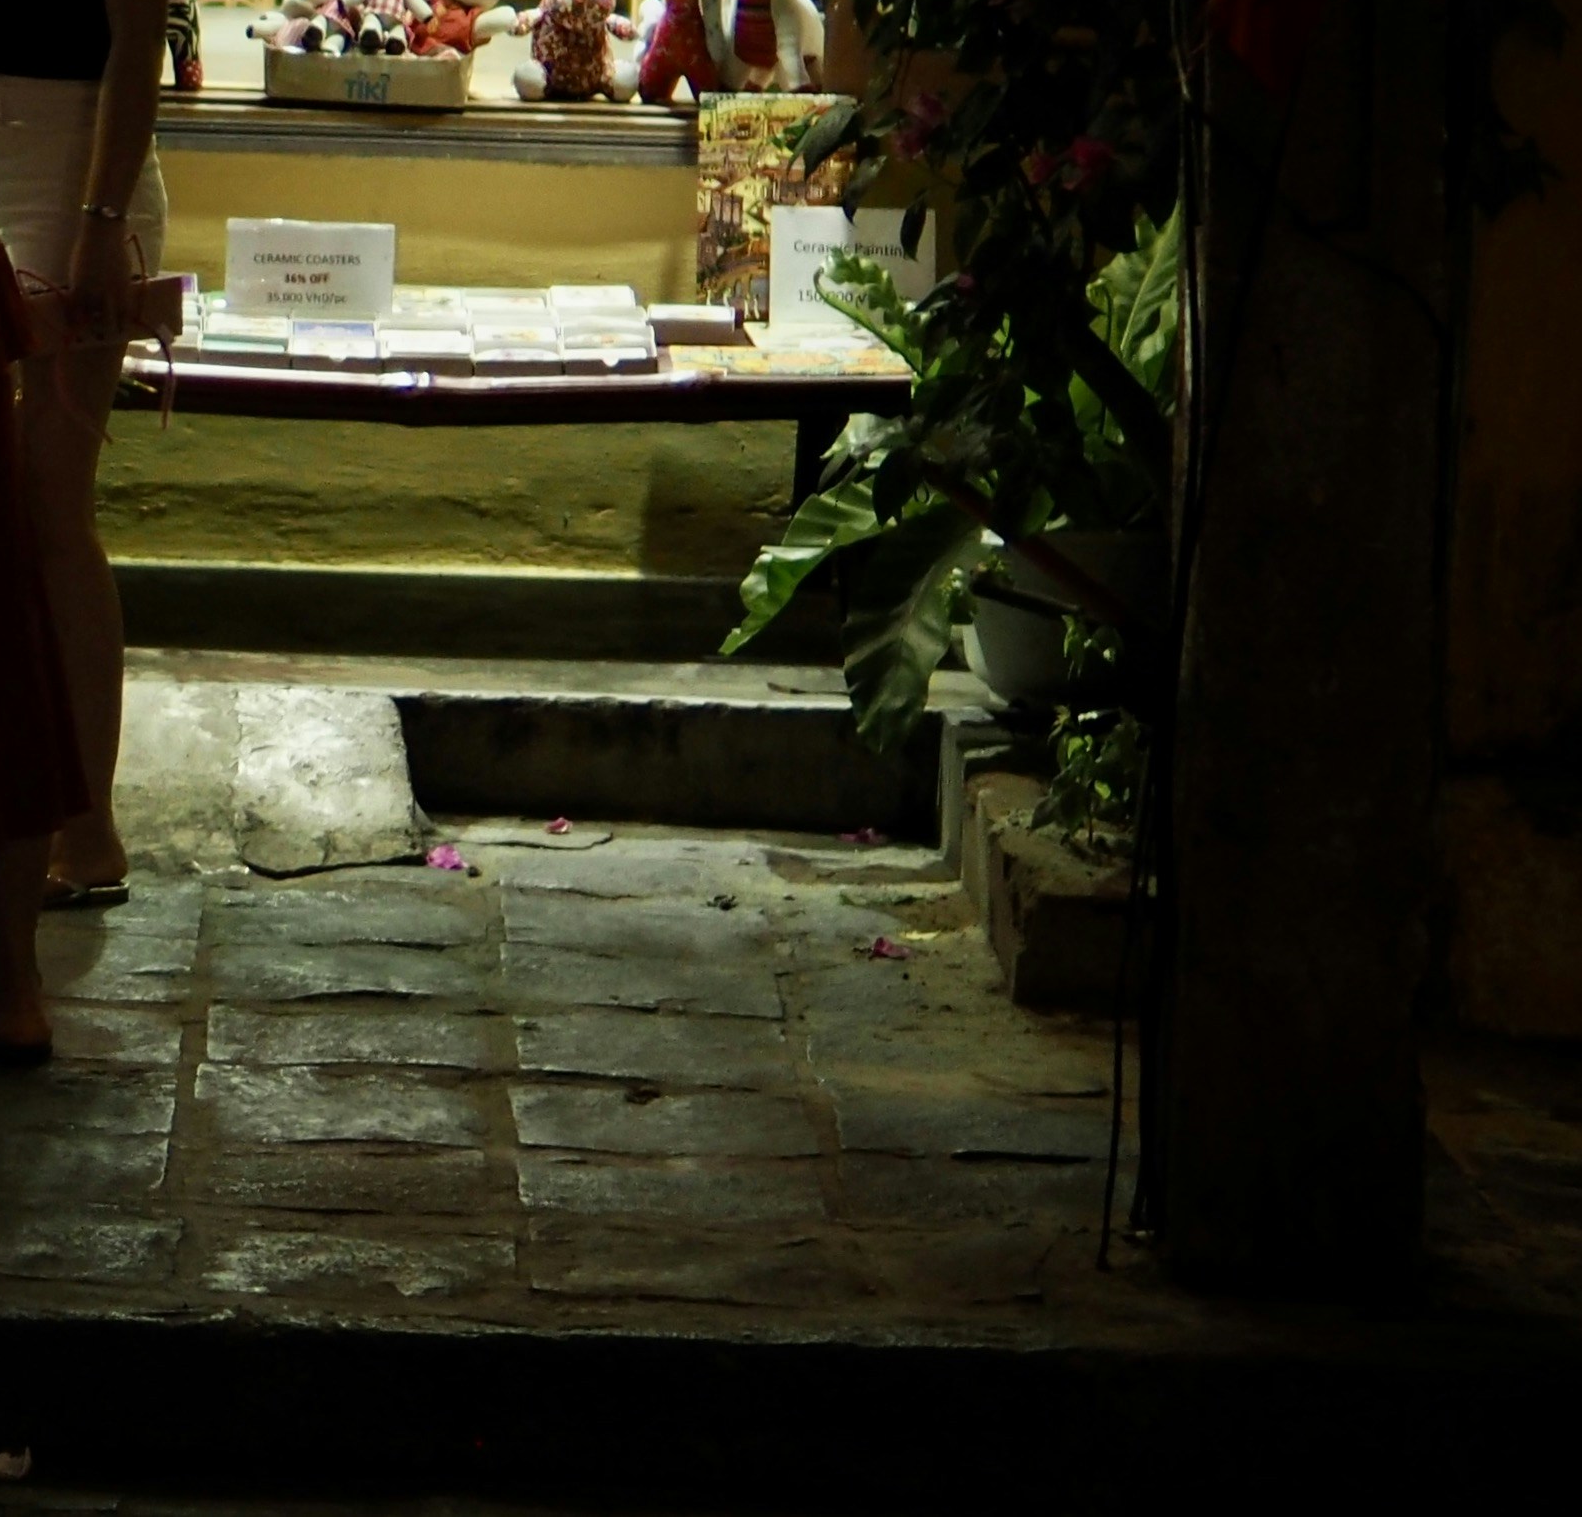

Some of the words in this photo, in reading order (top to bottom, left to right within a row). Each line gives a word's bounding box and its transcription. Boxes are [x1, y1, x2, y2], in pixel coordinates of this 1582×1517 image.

[253, 253, 303, 265] CERAMIC
[305, 254, 362, 266] COASTERS
[309, 272, 330, 284] OFF
